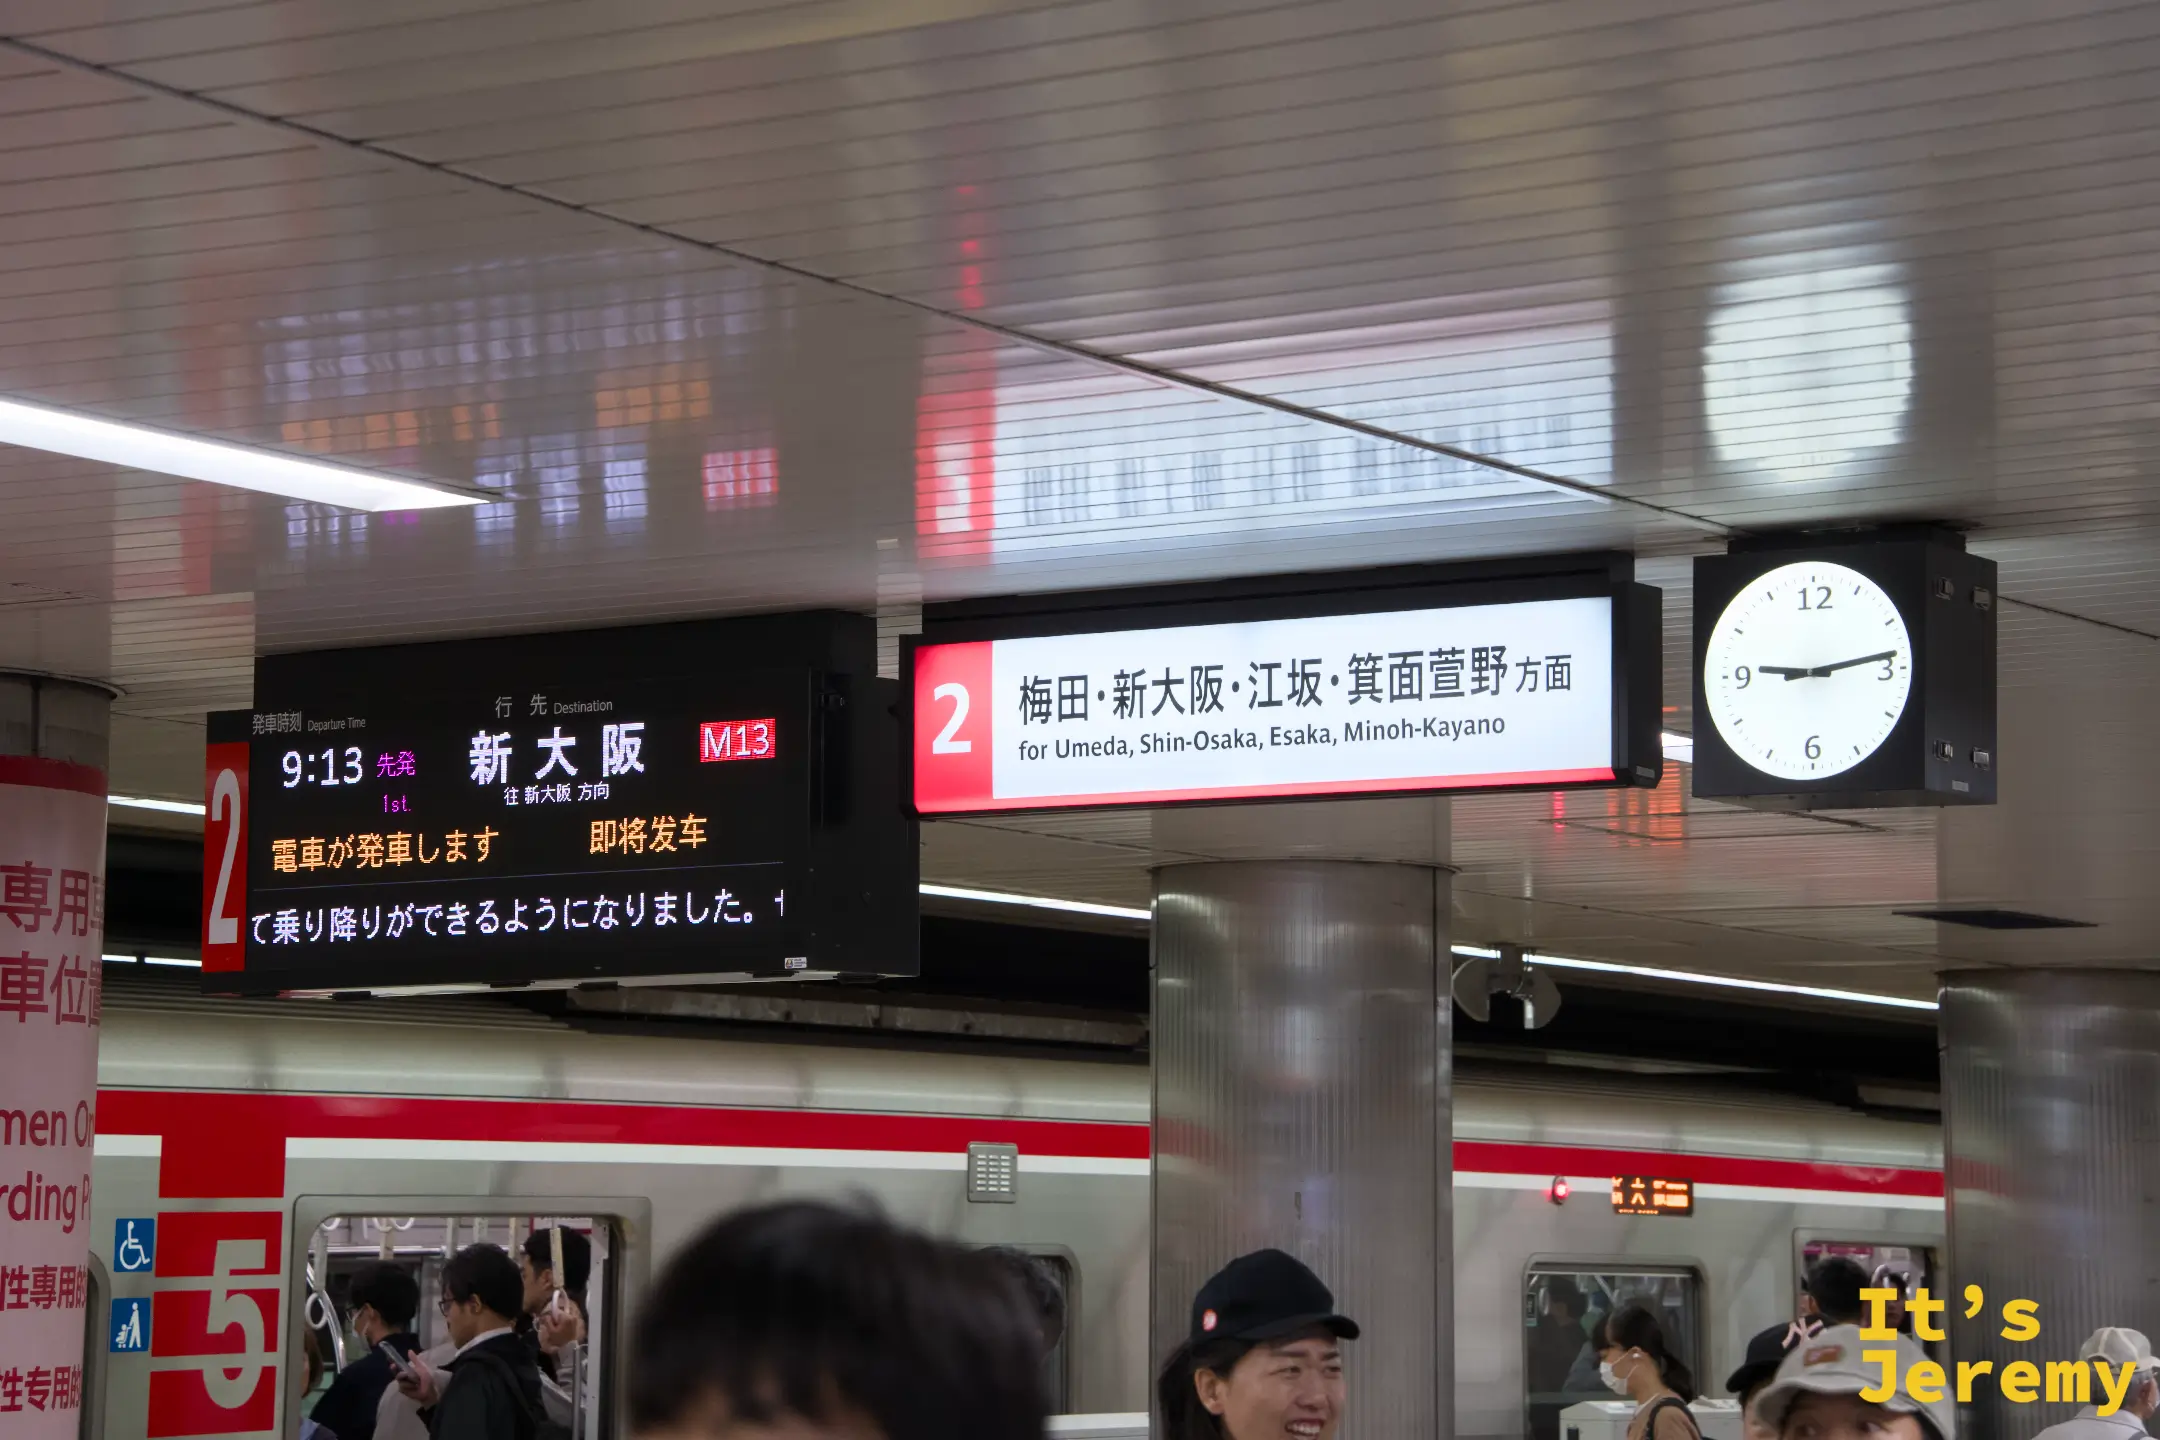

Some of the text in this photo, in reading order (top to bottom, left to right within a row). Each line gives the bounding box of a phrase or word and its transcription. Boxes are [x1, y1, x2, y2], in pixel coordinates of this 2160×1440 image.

[1797, 586, 1833, 610] 12
[1734, 666, 1751, 689] 9
[1877, 657, 1894, 681] 3
[553, 699, 613, 715] Destination
[932, 682, 972, 755] 2
[252, 711, 302, 735] 発車時刻
[307, 717, 367, 733] Departure Time
[1018, 716, 1506, 760] for Umeda, Shin-Osaka, Esaka, Minoh-Kayano
[469, 722, 645, 786] 新大阪
[704, 723, 770, 758] M13
[1804, 735, 1822, 760] 6
[282, 746, 363, 788] 9:13
[376, 751, 416, 777] 先発
[383, 794, 412, 813] 1st.
[524, 783, 572, 805] 新大阪
[577, 781, 610, 802] 方向
[272, 825, 499, 872] 電車が発車します
[589, 812, 707, 855] 即将发车
[208, 768, 241, 944] 2
[252, 888, 753, 944] て乗り降りができるようになりました。
[202, 1239, 267, 1409] 5
